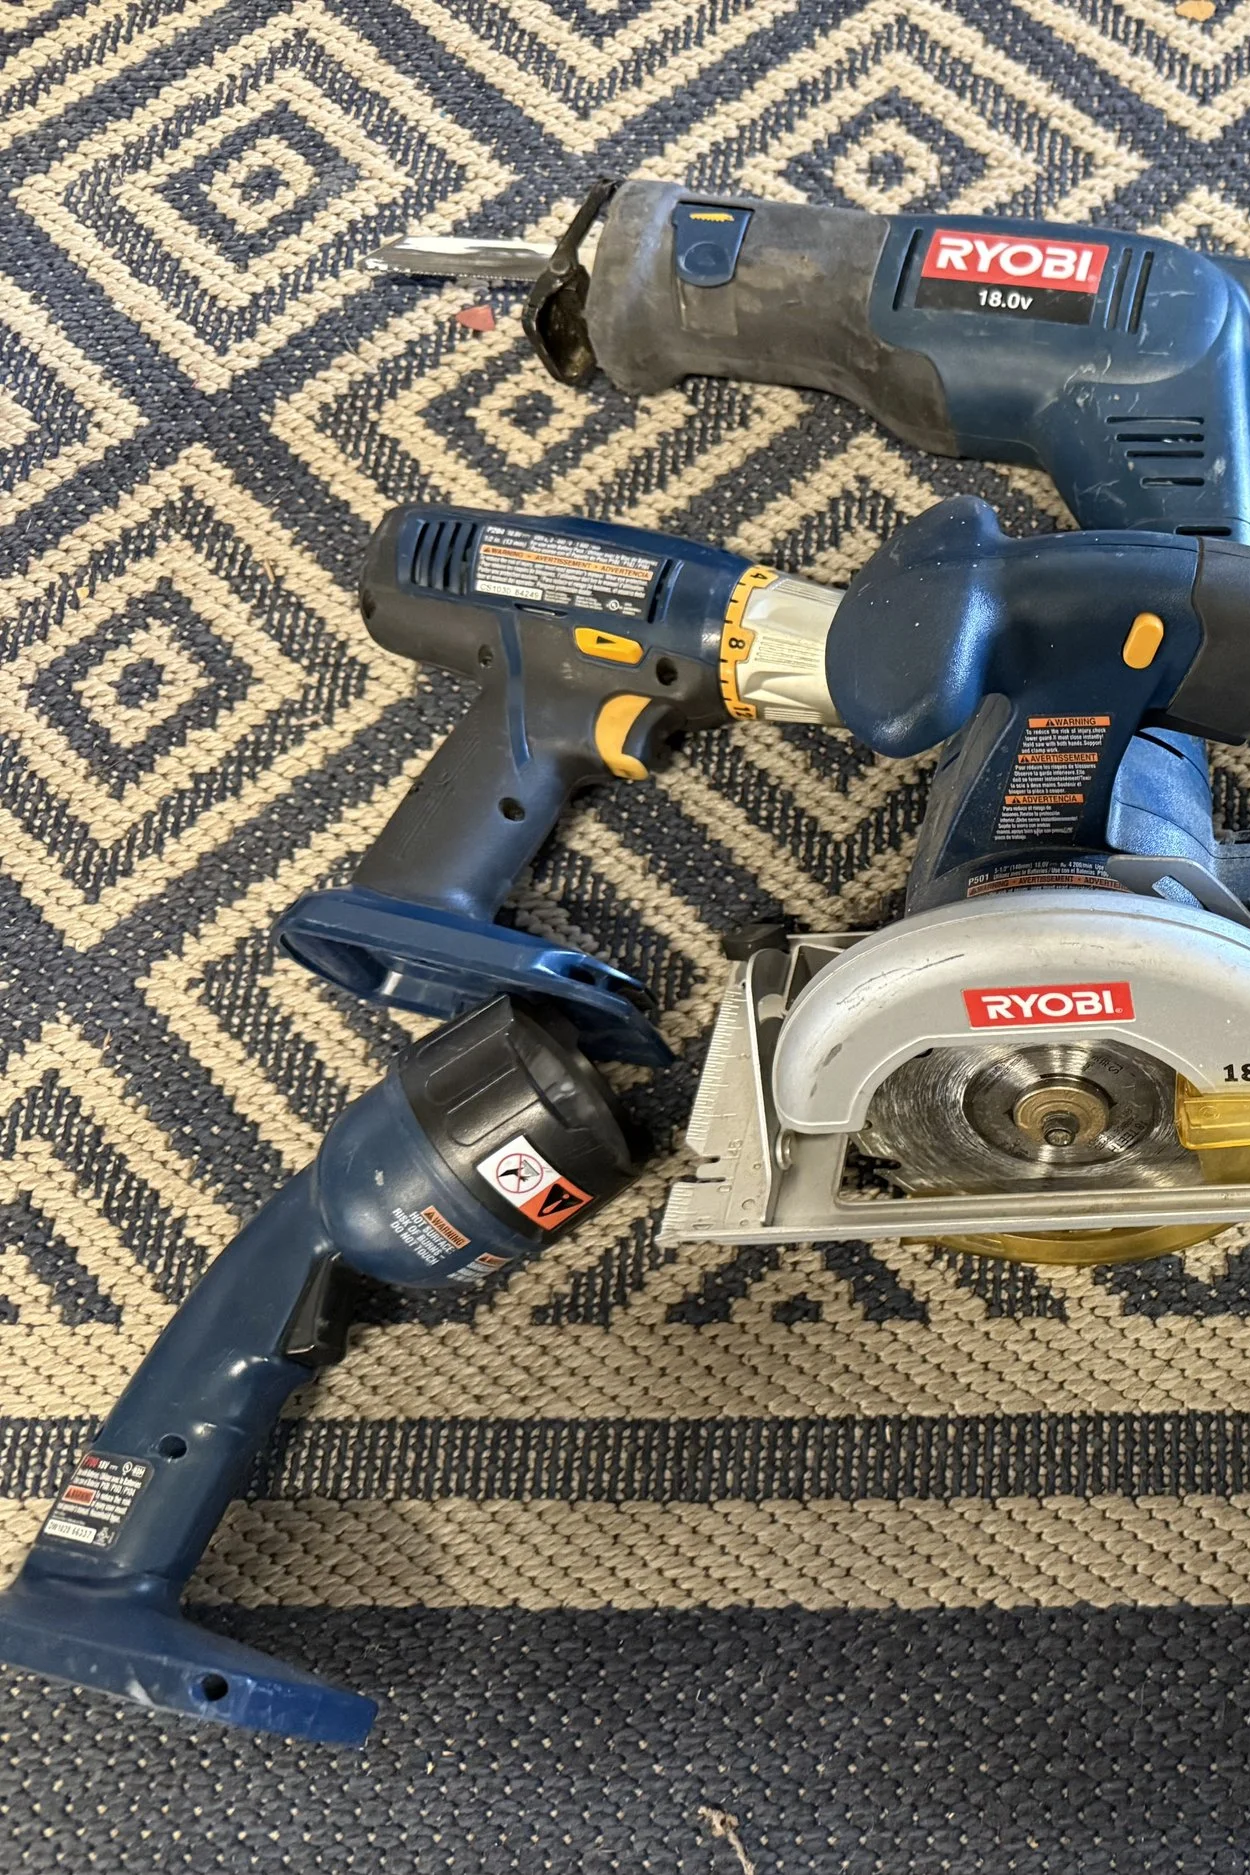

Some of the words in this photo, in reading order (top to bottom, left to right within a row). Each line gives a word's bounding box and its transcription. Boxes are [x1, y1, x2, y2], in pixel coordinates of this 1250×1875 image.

[936, 236, 1093, 281] RYOBI
[977, 289, 1033, 311] 18.0v
[491, 548, 524, 558] WARNING
[535, 555, 591, 569] AVERTISSEMENT
[601, 566, 649, 579] ADVERTENCIA
[749, 572, 768, 580] 4
[728, 637, 746, 650] 8
[1055, 718, 1096, 726] WARNING
[1022, 795, 1077, 803] ADVERTENCIA
[968, 874, 989, 886] P501
[1019, 876, 1074, 884] AVERTISSEMENT
[981, 991, 1114, 1020] RYOBI
[409, 1211, 427, 1227] HOT
[392, 1208, 412, 1227] RISK
[408, 1225, 422, 1235] OF
[416, 1234, 442, 1256] BURNS
[432, 1216, 464, 1246] WARNING
[390, 1221, 404, 1234] DO
[400, 1232, 419, 1247] NOT
[414, 1245, 440, 1266] TOUCH
